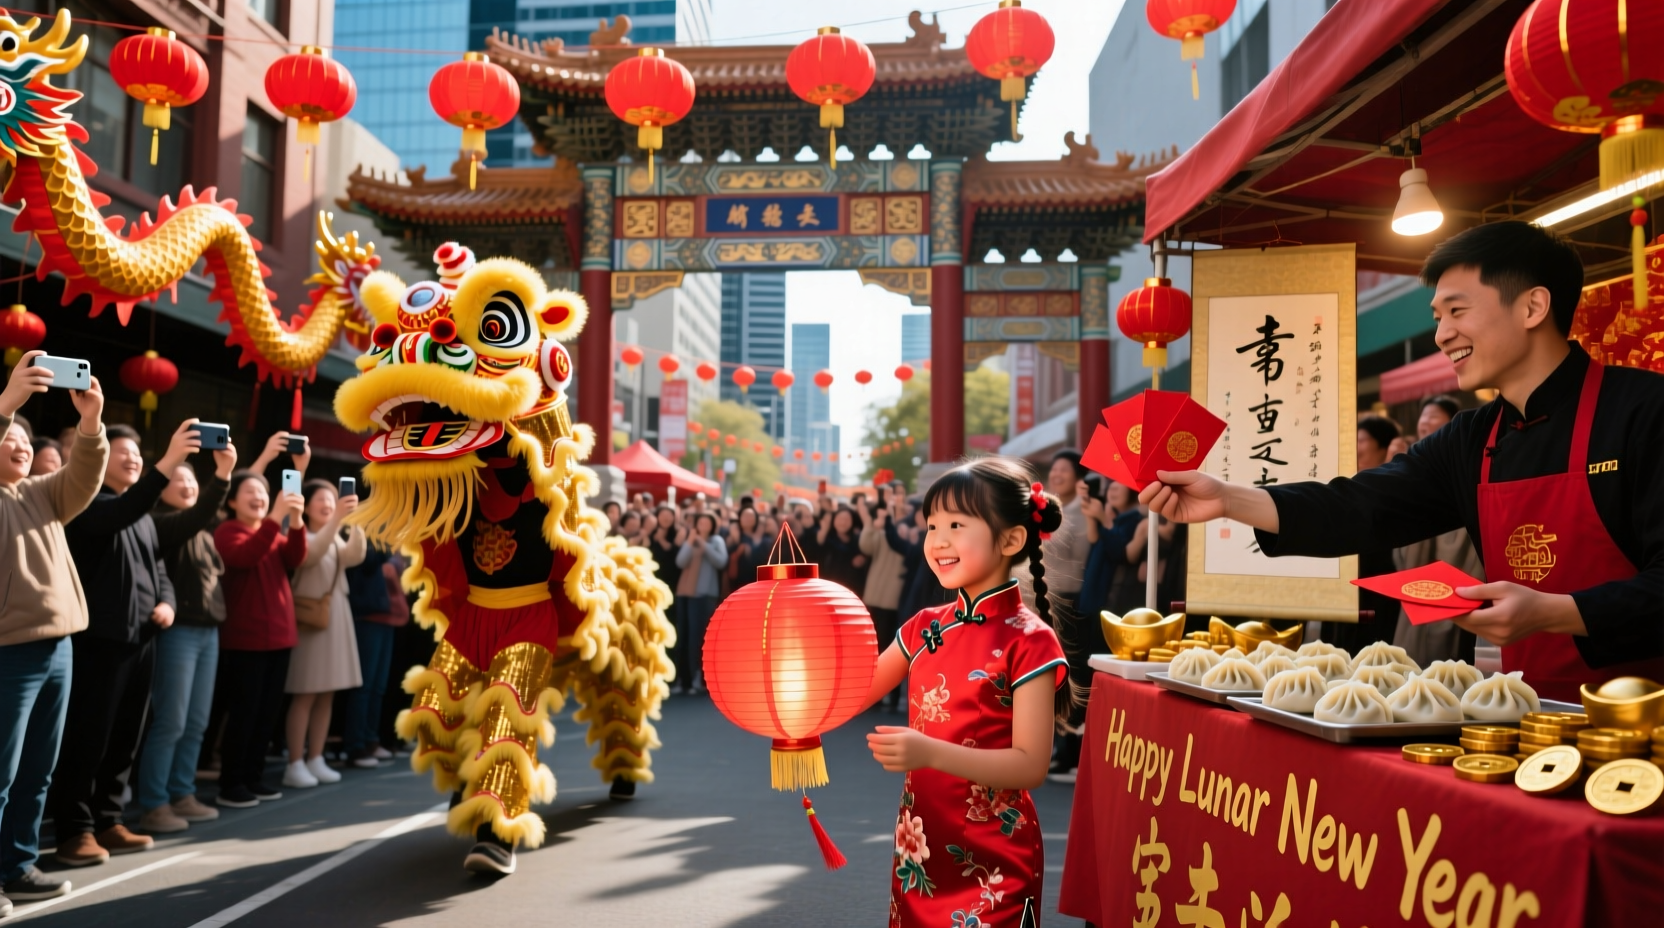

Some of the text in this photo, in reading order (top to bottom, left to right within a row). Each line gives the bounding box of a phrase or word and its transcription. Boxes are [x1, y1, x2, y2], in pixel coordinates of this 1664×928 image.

[1105, 707, 1174, 807] Happy
[1178, 732, 1271, 837] Lunar
[1277, 772, 1379, 890] New
[1396, 807, 1541, 928] Year
